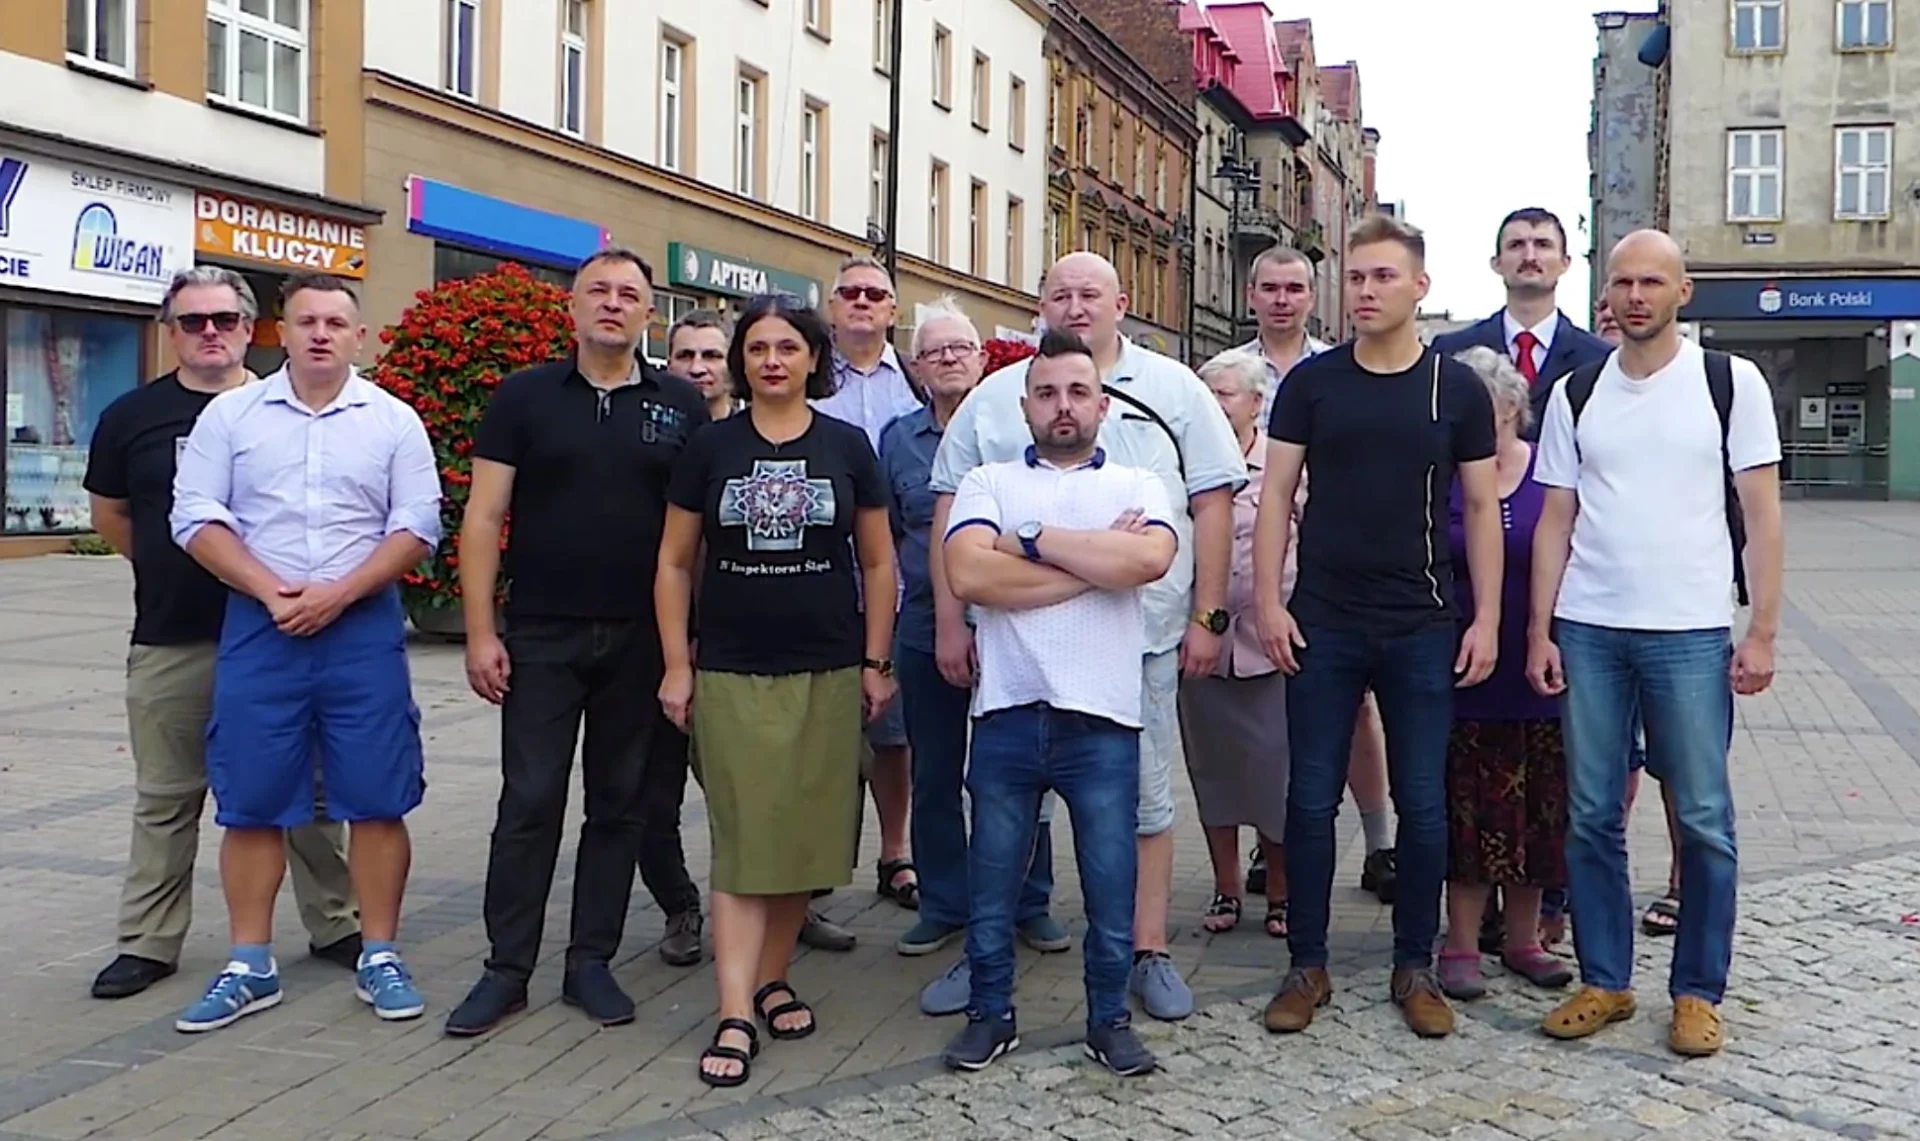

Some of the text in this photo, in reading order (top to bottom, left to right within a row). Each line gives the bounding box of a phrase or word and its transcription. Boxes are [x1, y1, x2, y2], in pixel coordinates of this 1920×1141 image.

[71, 171, 173, 203] SKLEP FIRMOWY
[197, 195, 365, 249] DORABIANIE
[93, 234, 164, 277] WISAN
[232, 229, 337, 269] KLUCZY
[710, 259, 769, 294] APTEKA
[1788, 291, 1873, 307] Bank Polski
